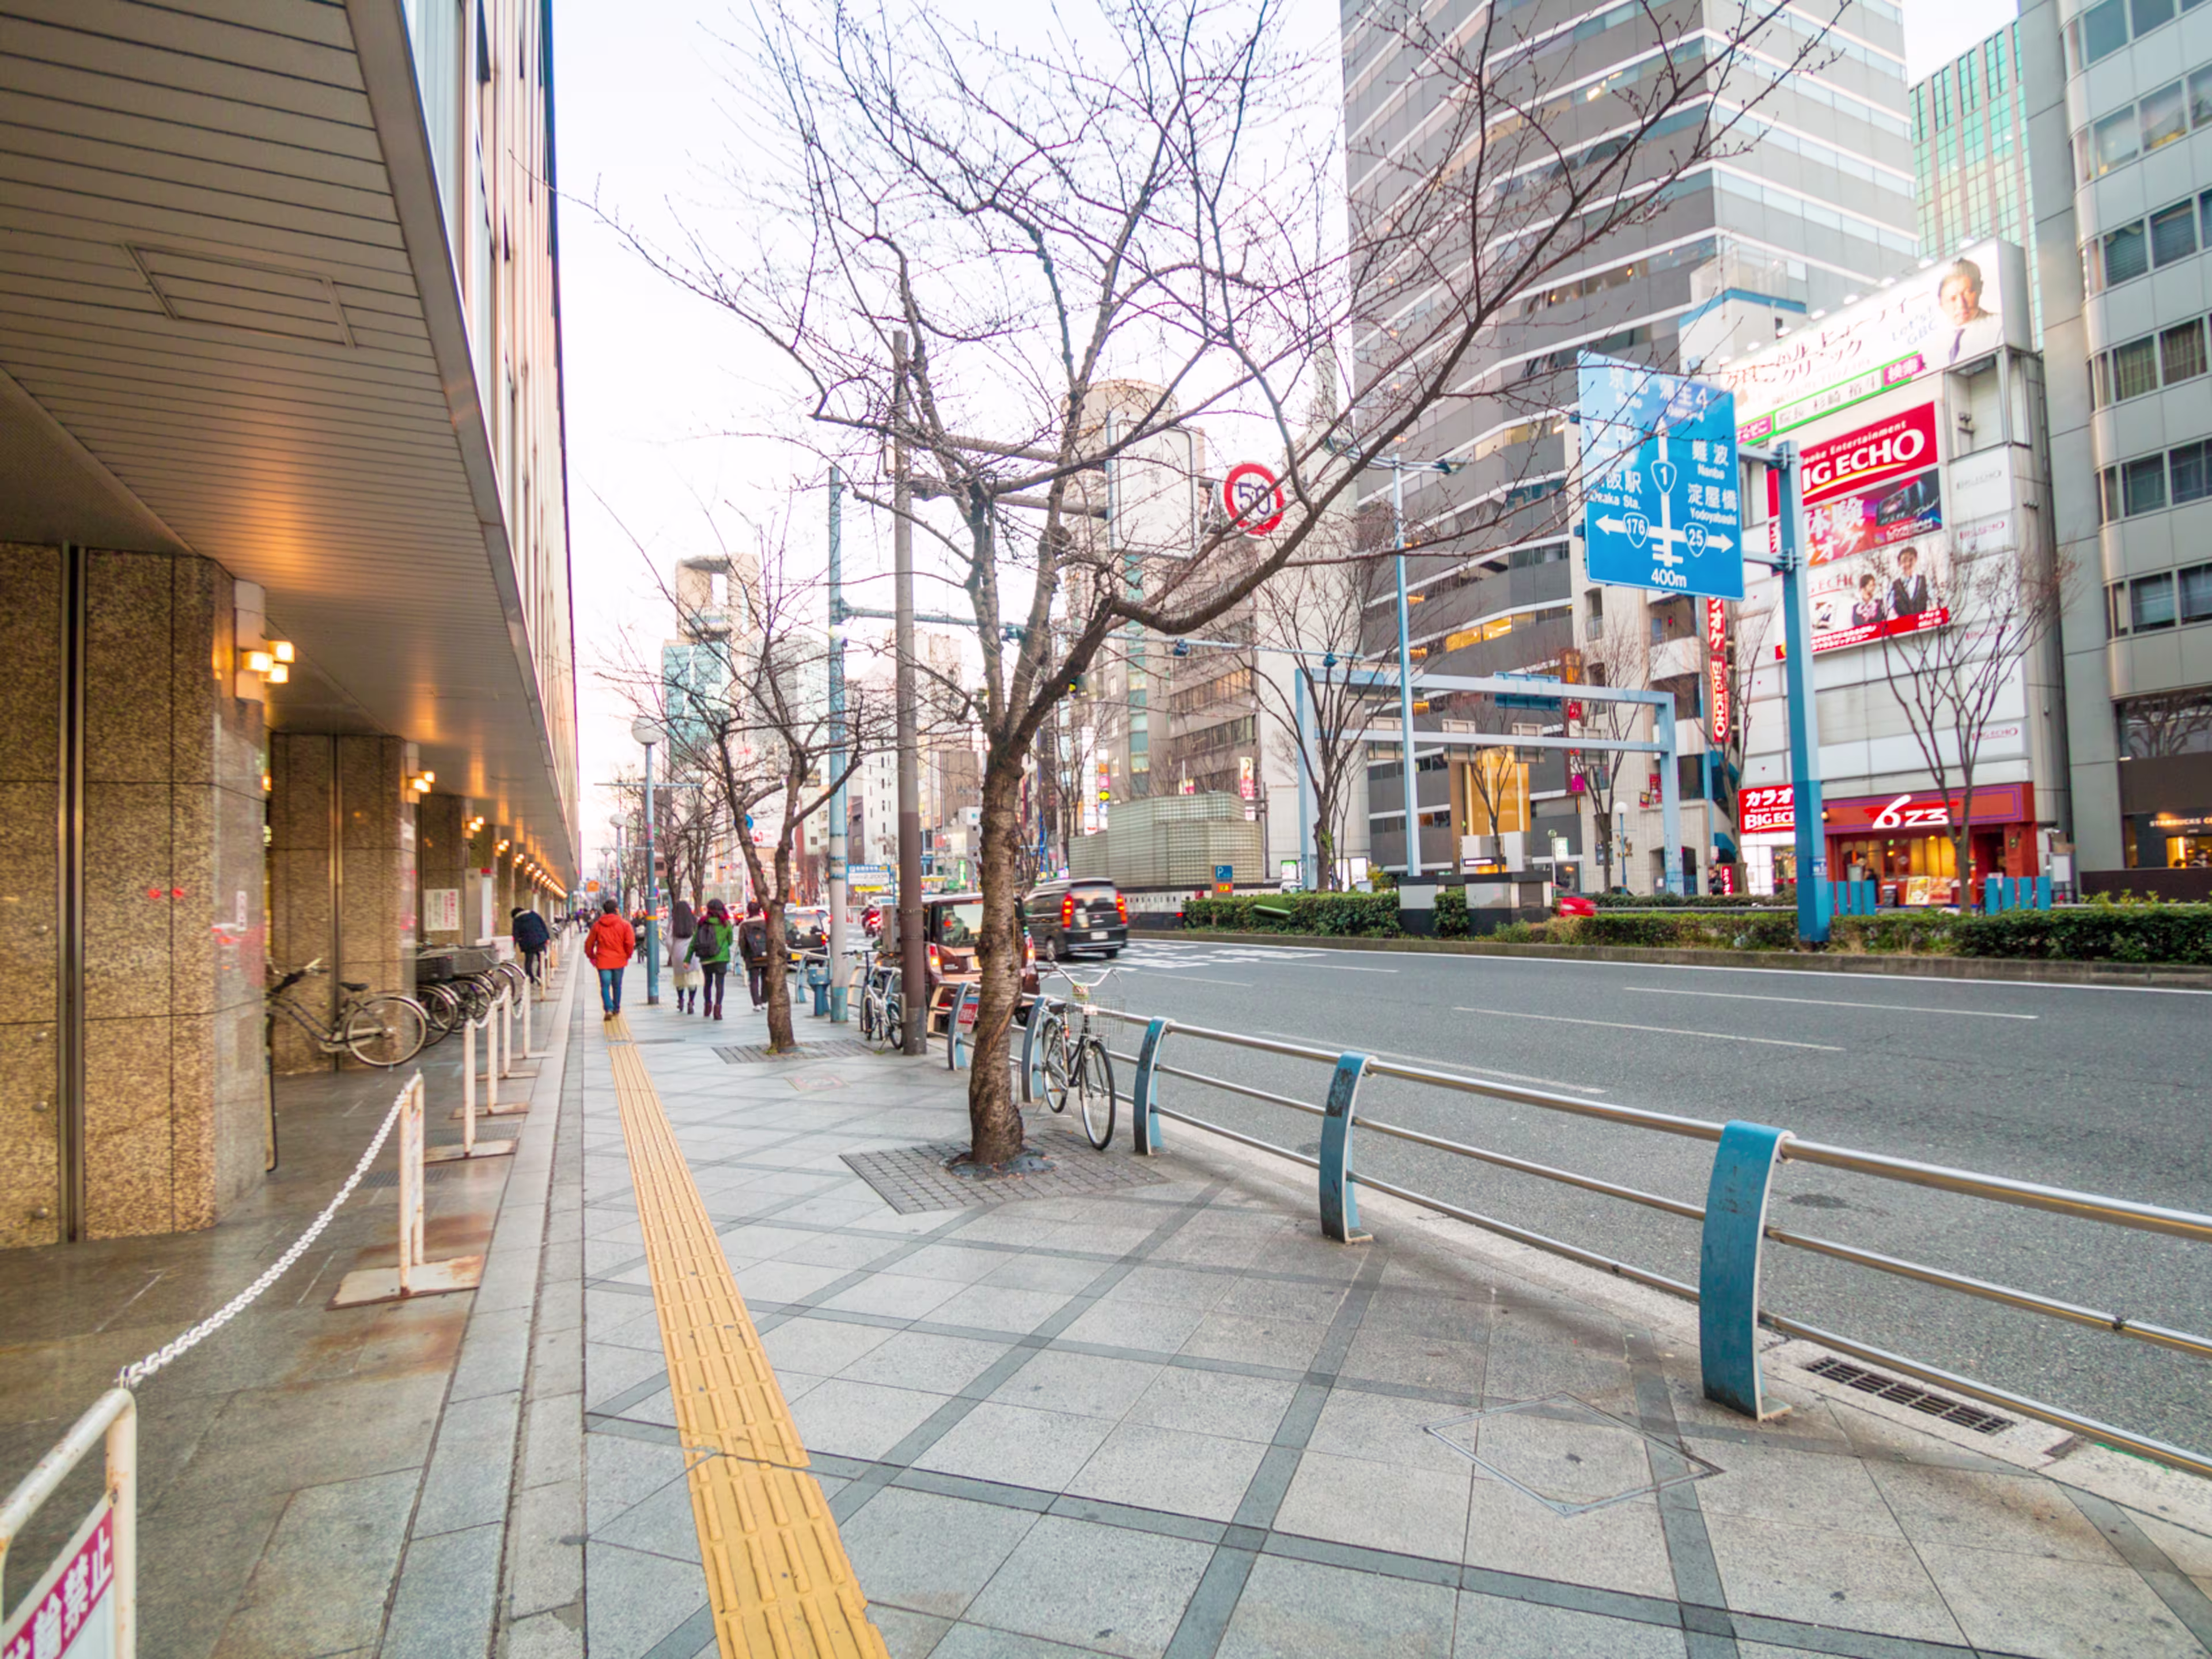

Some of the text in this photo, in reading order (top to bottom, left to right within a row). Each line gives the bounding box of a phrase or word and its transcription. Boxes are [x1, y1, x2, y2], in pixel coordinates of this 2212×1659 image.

[1830, 420, 1907, 455] Entertainment
[1692, 440, 1729, 467] 難波
[1802, 428, 1925, 491] IG ECHO
[1238, 482, 1271, 515] 50
[1688, 483, 1737, 512] 淀屋橋
[1626, 517, 1645, 536] 176
[1688, 528, 1703, 547] 25
[1806, 530, 1865, 562] ラオケ
[1652, 568, 1687, 588] 400m
[1709, 597, 1724, 650] ラオケ
[1714, 693, 1725, 737] ECHO
[1745, 787, 1793, 807] カラオ
[1744, 813, 1772, 830] BIG
